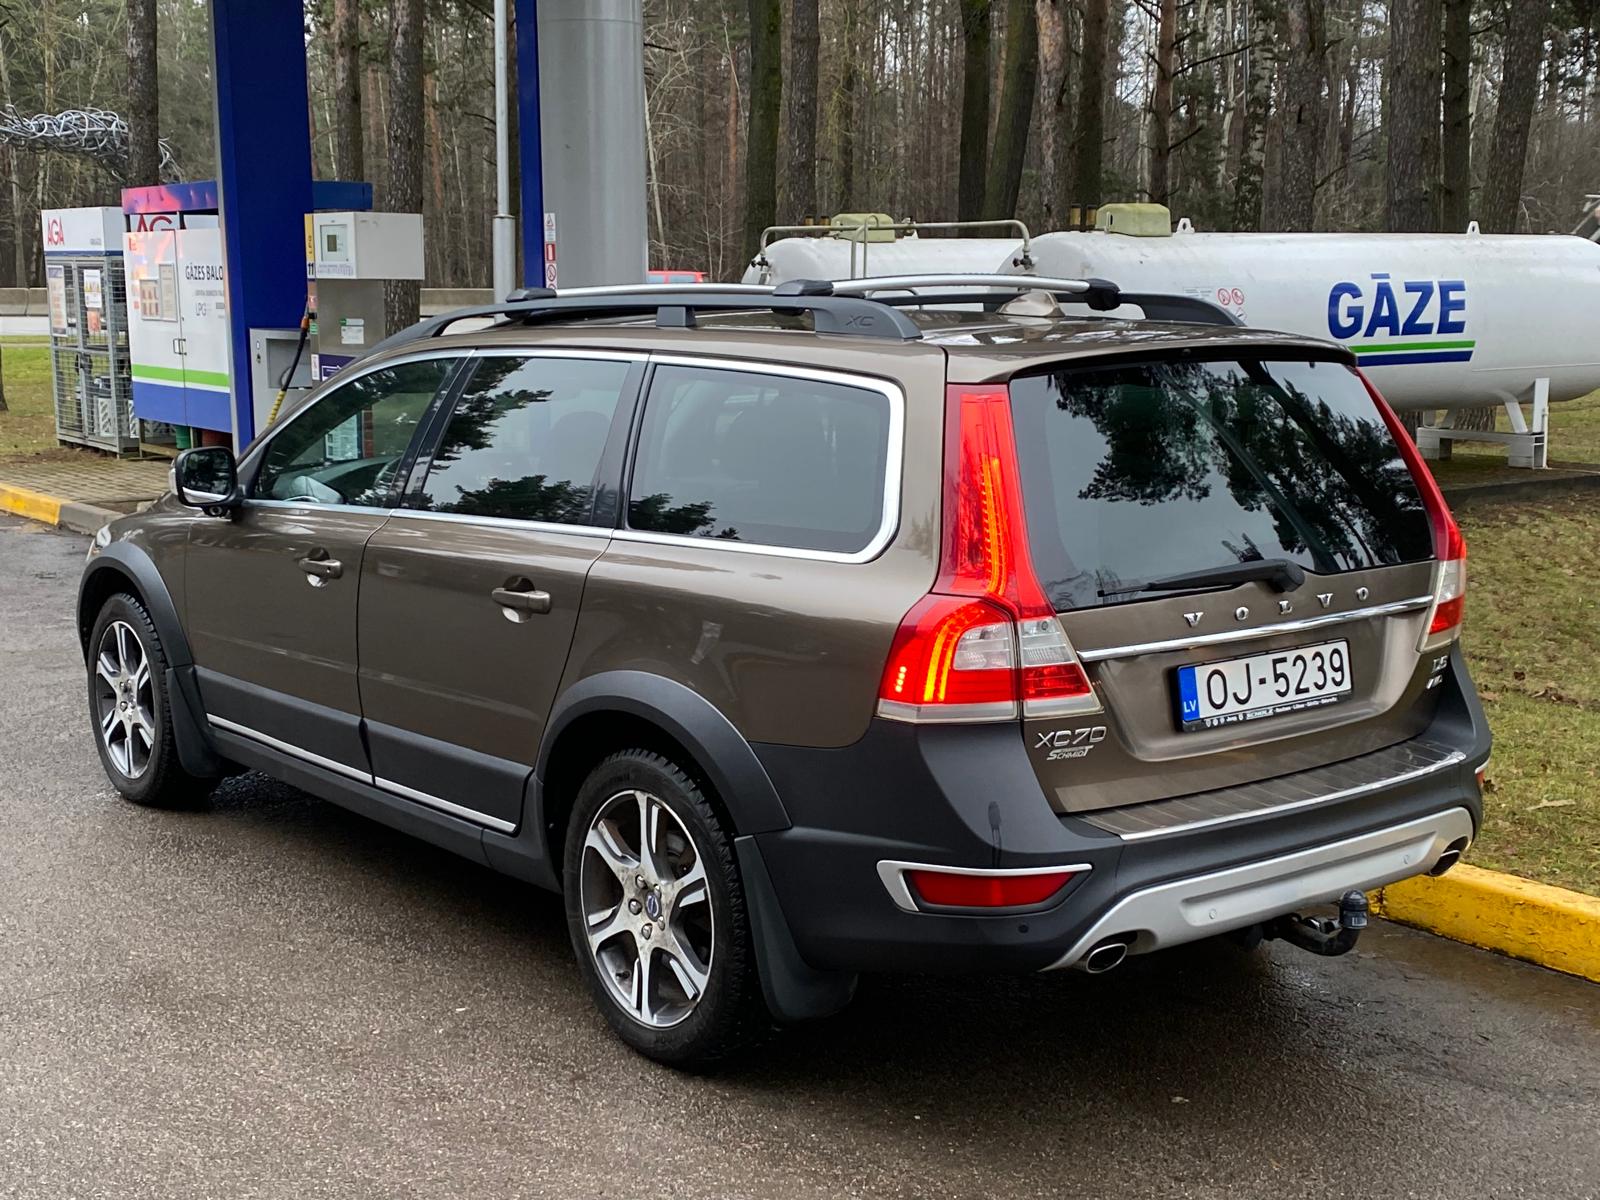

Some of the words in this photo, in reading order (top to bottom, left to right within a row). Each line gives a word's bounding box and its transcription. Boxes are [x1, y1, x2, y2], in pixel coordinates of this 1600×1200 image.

[47, 216, 65, 246] AGA
[845, 314, 874, 327] XC
[1328, 273, 1466, 339] GĀZE
[1183, 586, 1370, 628] VOLVO
[1206, 647, 1345, 710] OJ-5239
[1183, 700, 1197, 713] LV
[1034, 726, 1107, 748] XC70
